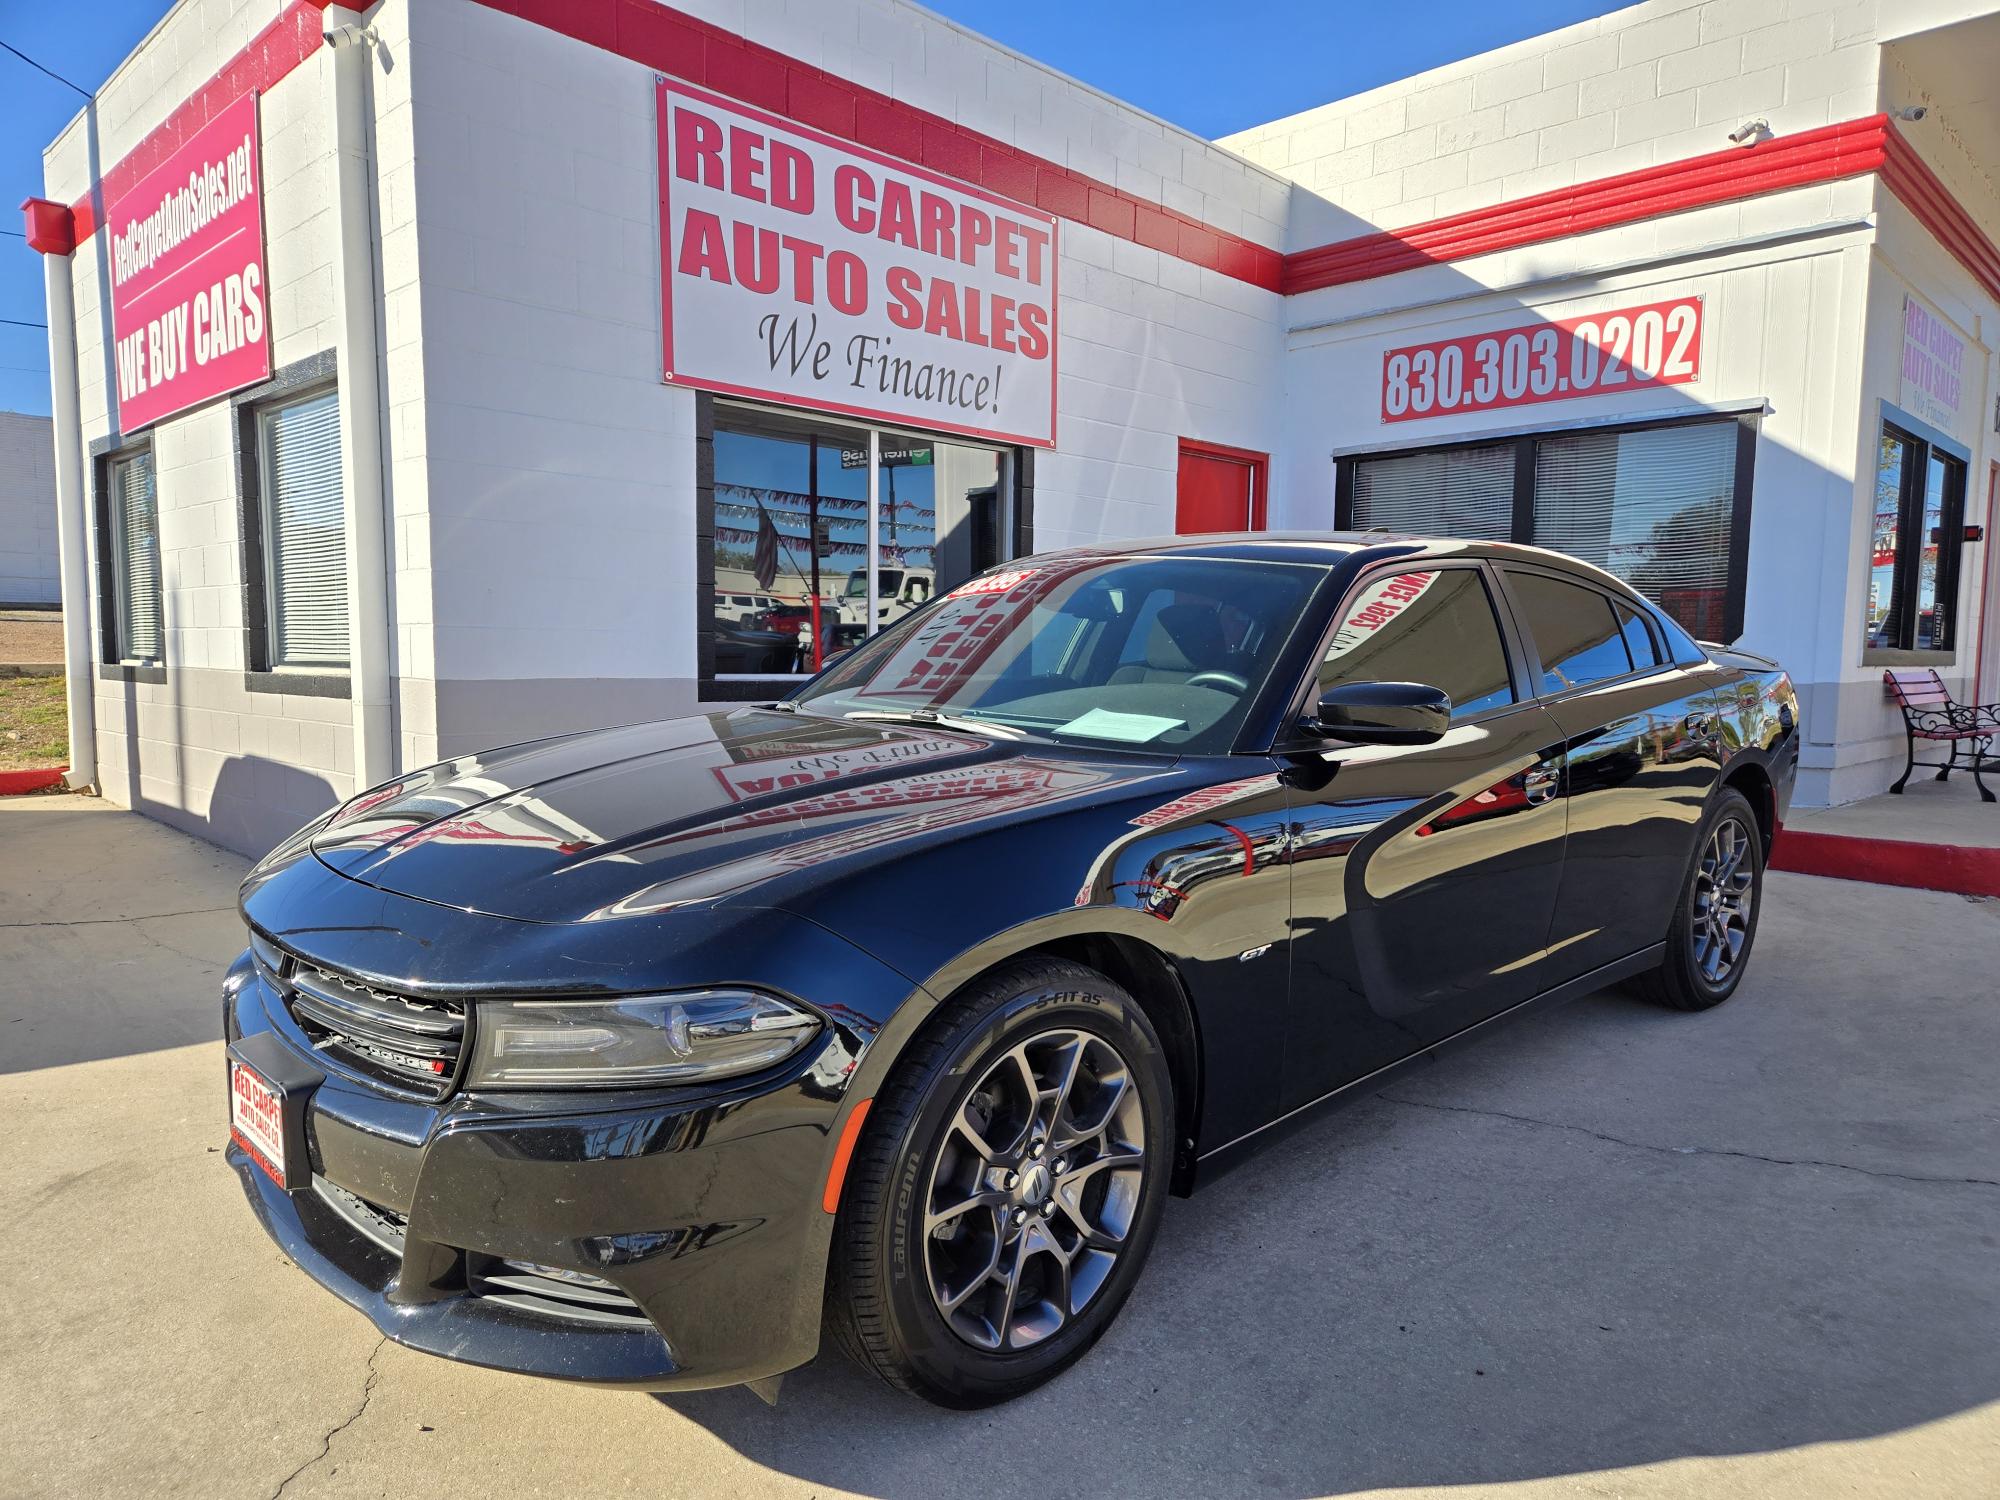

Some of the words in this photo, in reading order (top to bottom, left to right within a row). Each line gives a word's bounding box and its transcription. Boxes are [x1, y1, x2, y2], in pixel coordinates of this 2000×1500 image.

[113, 133, 253, 287] RedCarpetAutoSales.net
[674, 105, 815, 216] RED
[833, 164, 1050, 286] CARPET
[117, 327, 148, 402] WE
[148, 300, 190, 388] BUY
[193, 262, 264, 367] CARS
[677, 207, 869, 316] AUTO
[885, 265, 1049, 361] SALES
[758, 312, 832, 380] We
[846, 333, 1002, 414] Finance!
[1385, 304, 1698, 416] 830.303.0202
[1052, 991, 1079, 1004] FIT
[1239, 943, 1272, 962] GT
[234, 1068, 252, 1103] RED
[369, 1046, 435, 1071] DODGE
[239, 1099, 255, 1125] AUTO
[255, 1110, 271, 1140] SALES
